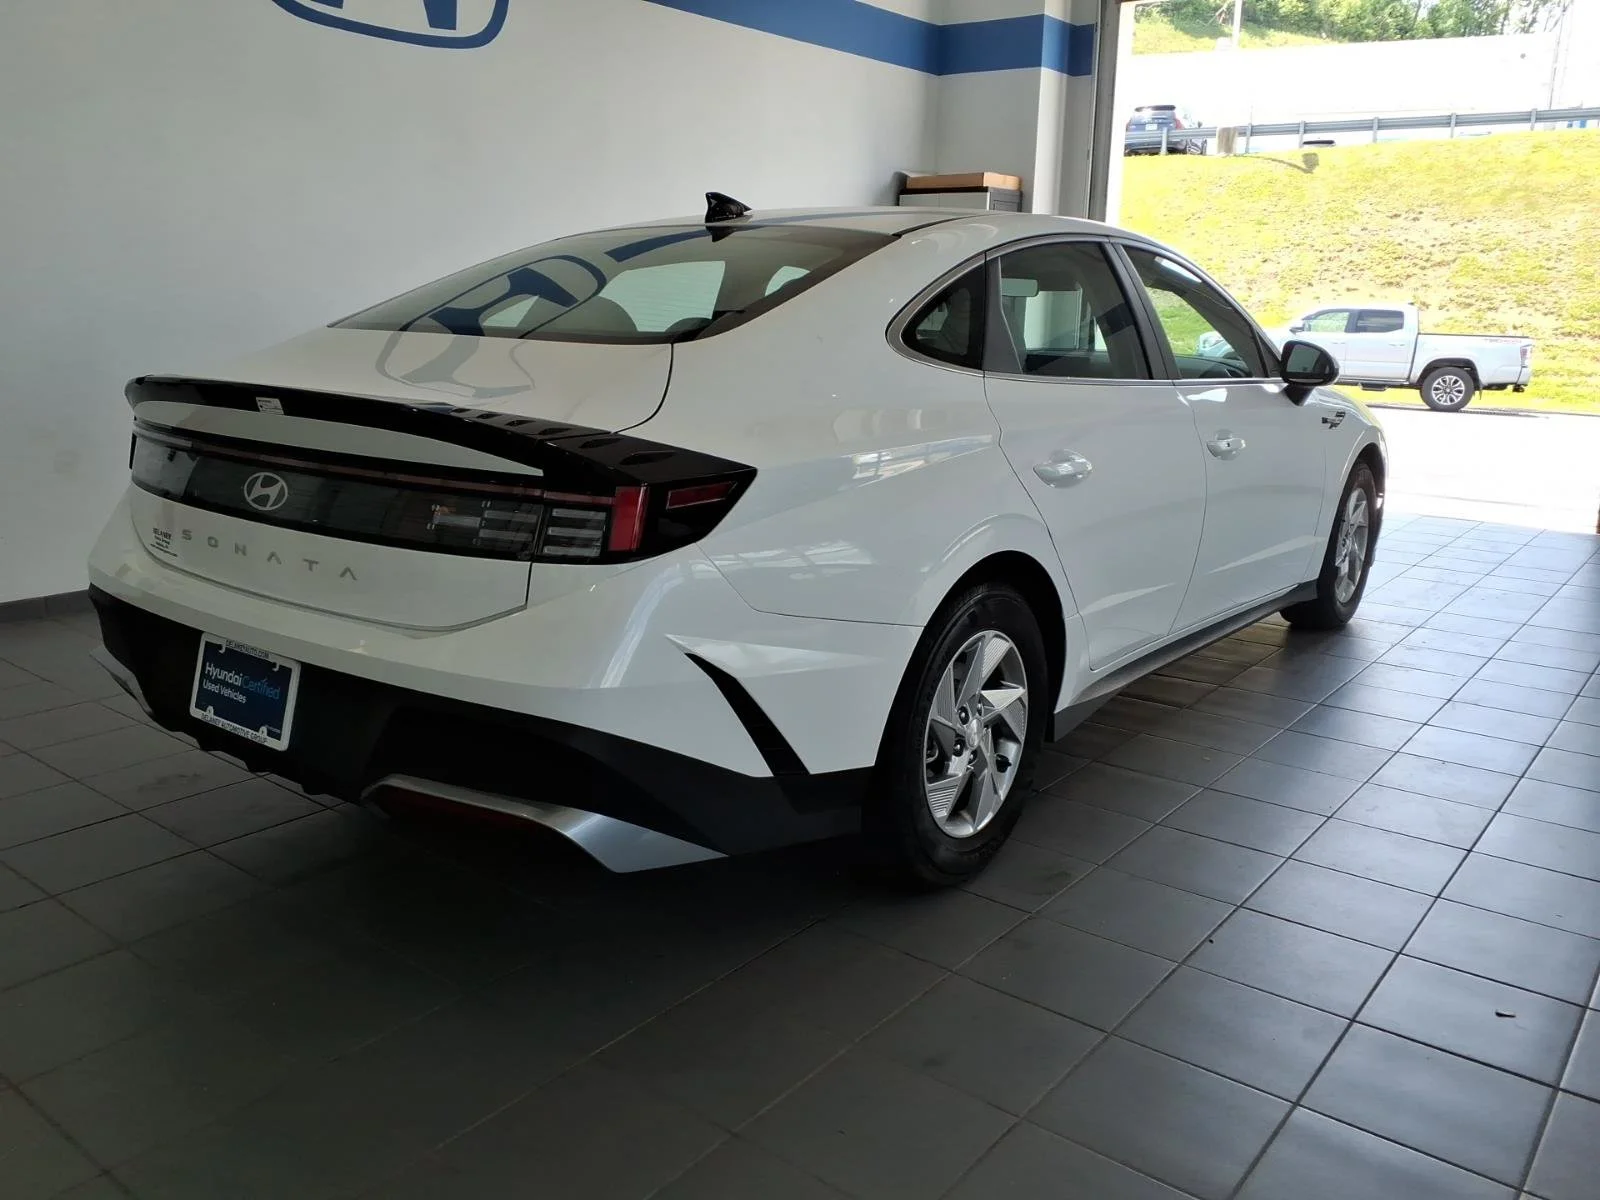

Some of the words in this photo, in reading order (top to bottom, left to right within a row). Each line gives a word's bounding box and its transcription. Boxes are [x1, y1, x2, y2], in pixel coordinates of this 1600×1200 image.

[181, 529, 358, 581] SONATA
[203, 679, 219, 693] Used
[220, 684, 247, 704] Vehicles
[205, 662, 243, 686] Hyundai
[243, 675, 281, 700] Certified
